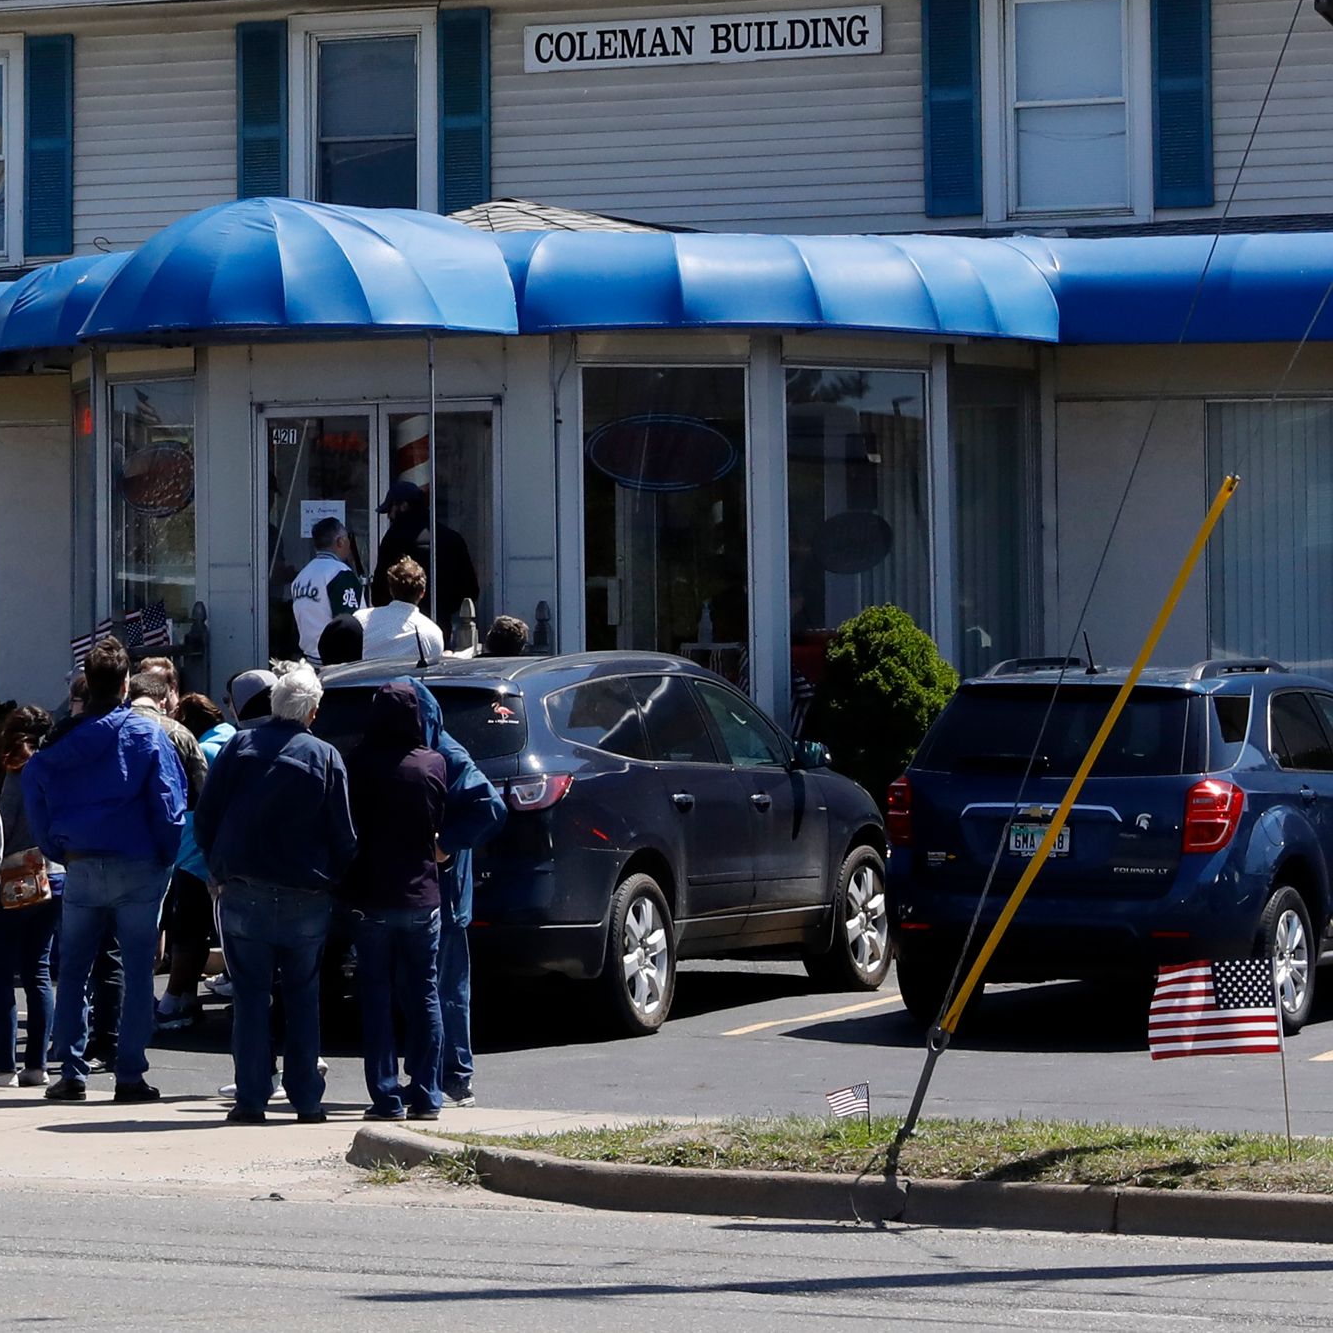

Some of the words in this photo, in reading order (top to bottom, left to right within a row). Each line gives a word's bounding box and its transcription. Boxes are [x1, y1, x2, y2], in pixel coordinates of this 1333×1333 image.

[534, 25, 695, 64] COLEMAN
[710, 14, 870, 55] BUILDING
[273, 429, 297, 445] 421
[1113, 867, 1156, 875] EQUINOX
